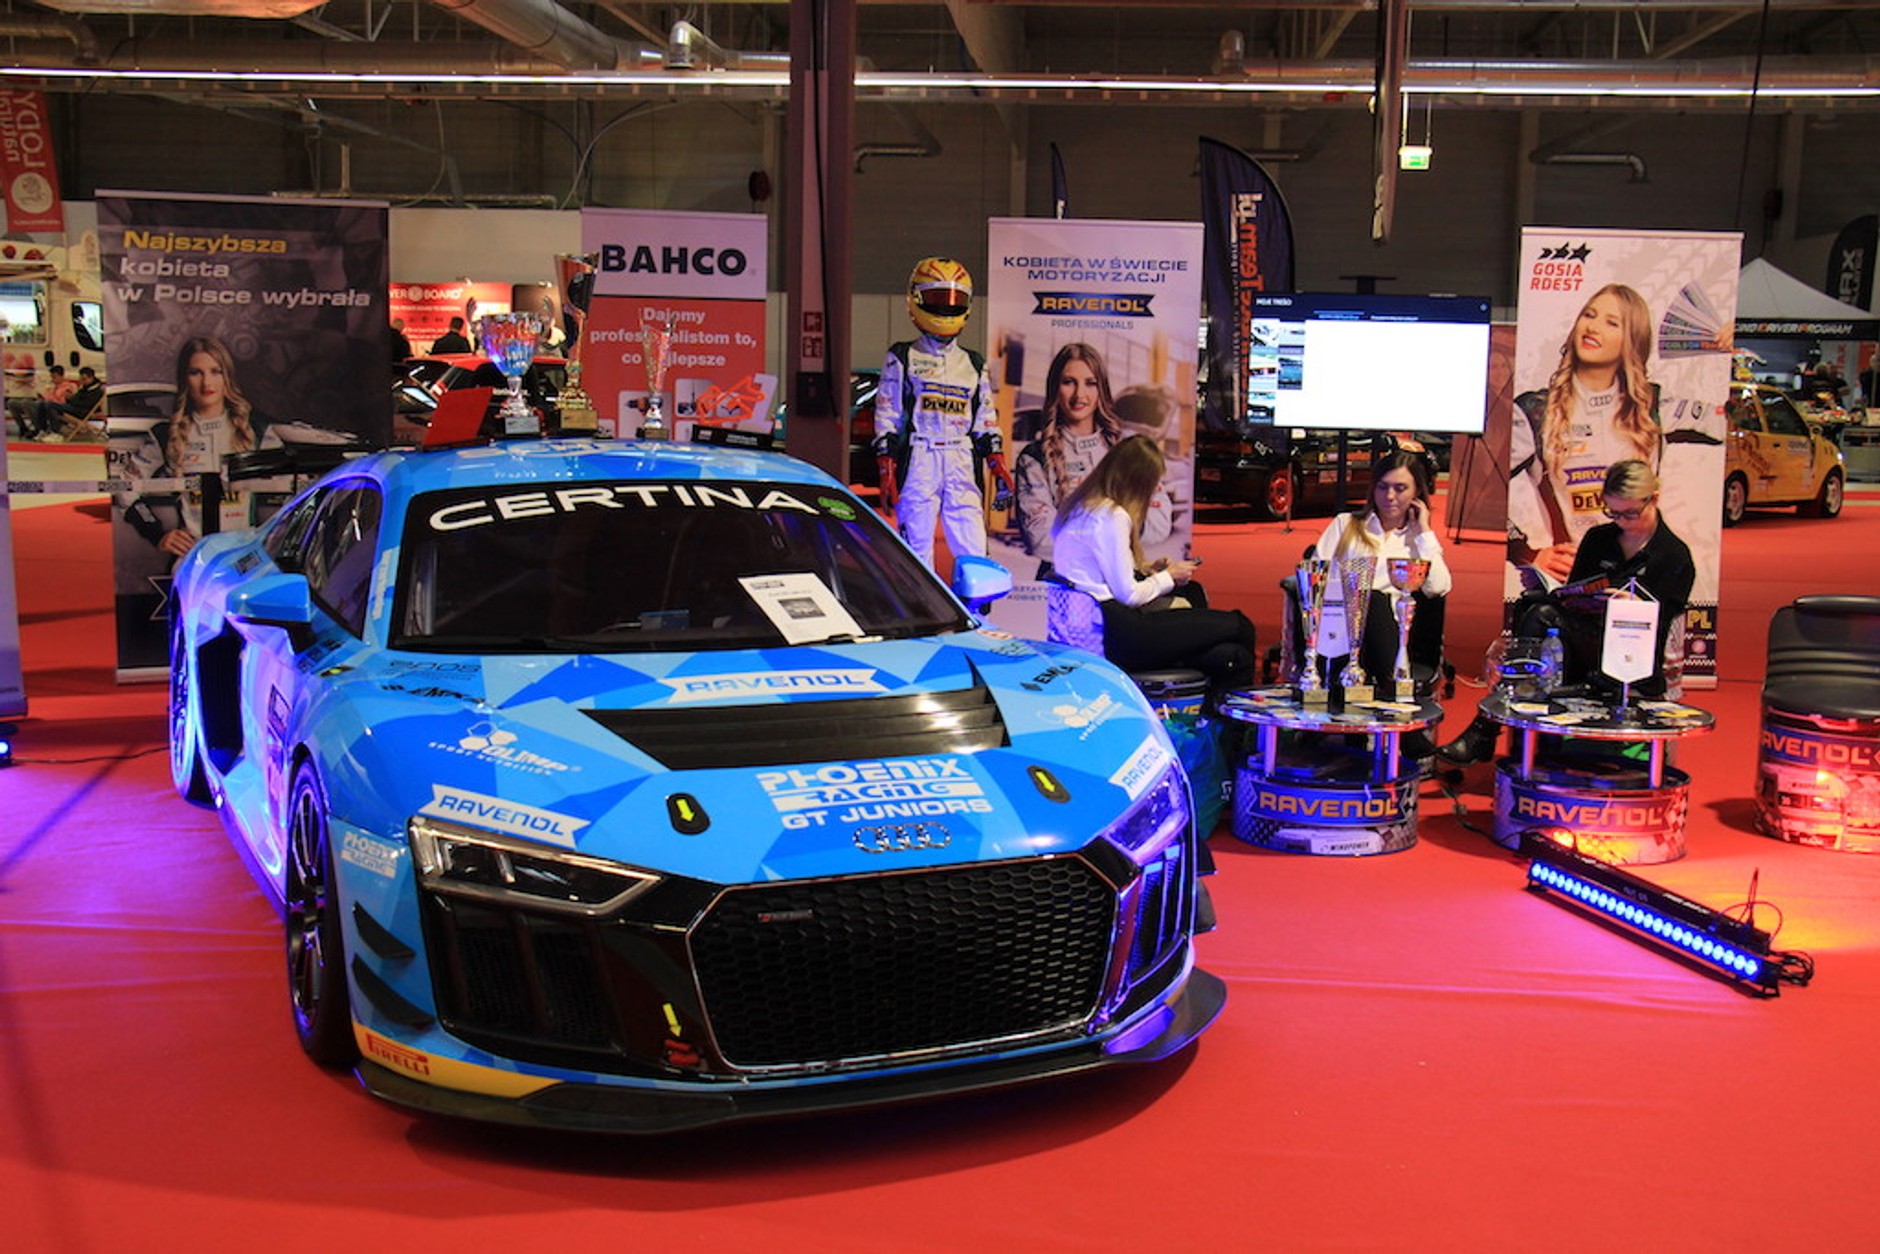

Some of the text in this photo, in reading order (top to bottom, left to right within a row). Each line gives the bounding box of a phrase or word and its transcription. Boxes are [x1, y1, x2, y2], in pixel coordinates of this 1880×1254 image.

[122, 229, 288, 254] Najszybsza
[120, 257, 231, 278] kobieta
[602, 244, 747, 276] BAHCO
[1003, 255, 1188, 271] KOBIETA W ŚWIECIE
[1533, 262, 1583, 276] GOSIA
[1027, 270, 1166, 283] MOTORYZACJI
[1530, 277, 1584, 291] RDEST
[117, 284, 371, 309] w Polsce wybrała
[1042, 297, 1145, 312] RAVENOL
[1051, 319, 1134, 330] PROFESSIONALS
[734, 332, 757, 348] to,
[621, 352, 642, 364] co
[429, 484, 820, 531] CERTINA
[1687, 610, 1712, 629] PL
[685, 674, 865, 693] RAVENOL
[438, 794, 564, 836] RAVENOL
[781, 798, 993, 830] GT JUNIORS
[1259, 791, 1399, 819] RAVENOL
[1518, 796, 1663, 827] RAVENOL
[366, 1033, 430, 1077] PIRELLI
